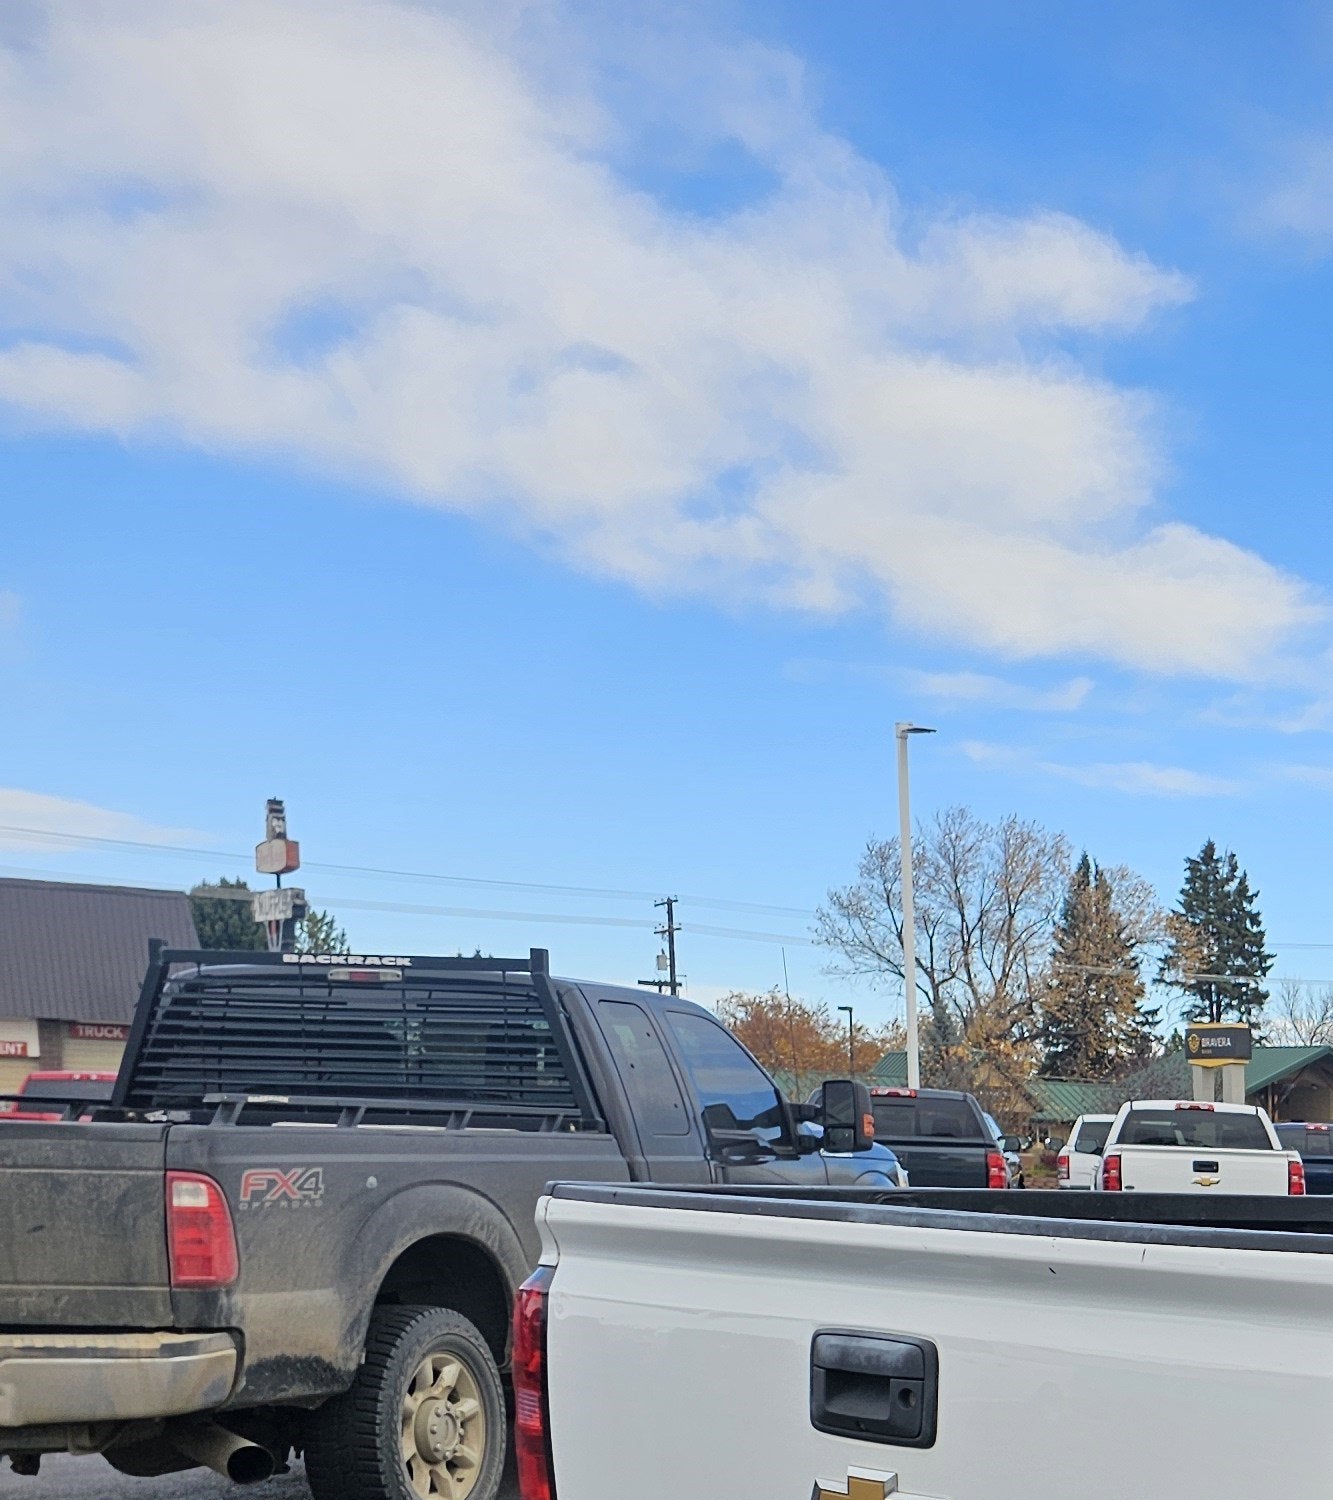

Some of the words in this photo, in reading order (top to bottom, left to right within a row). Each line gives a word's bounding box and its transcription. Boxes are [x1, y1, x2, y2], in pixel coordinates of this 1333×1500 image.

[283, 953, 413, 967] BACKRACK
[75, 1025, 123, 1038] TRUCK
[240, 1167, 325, 1201] FX4
